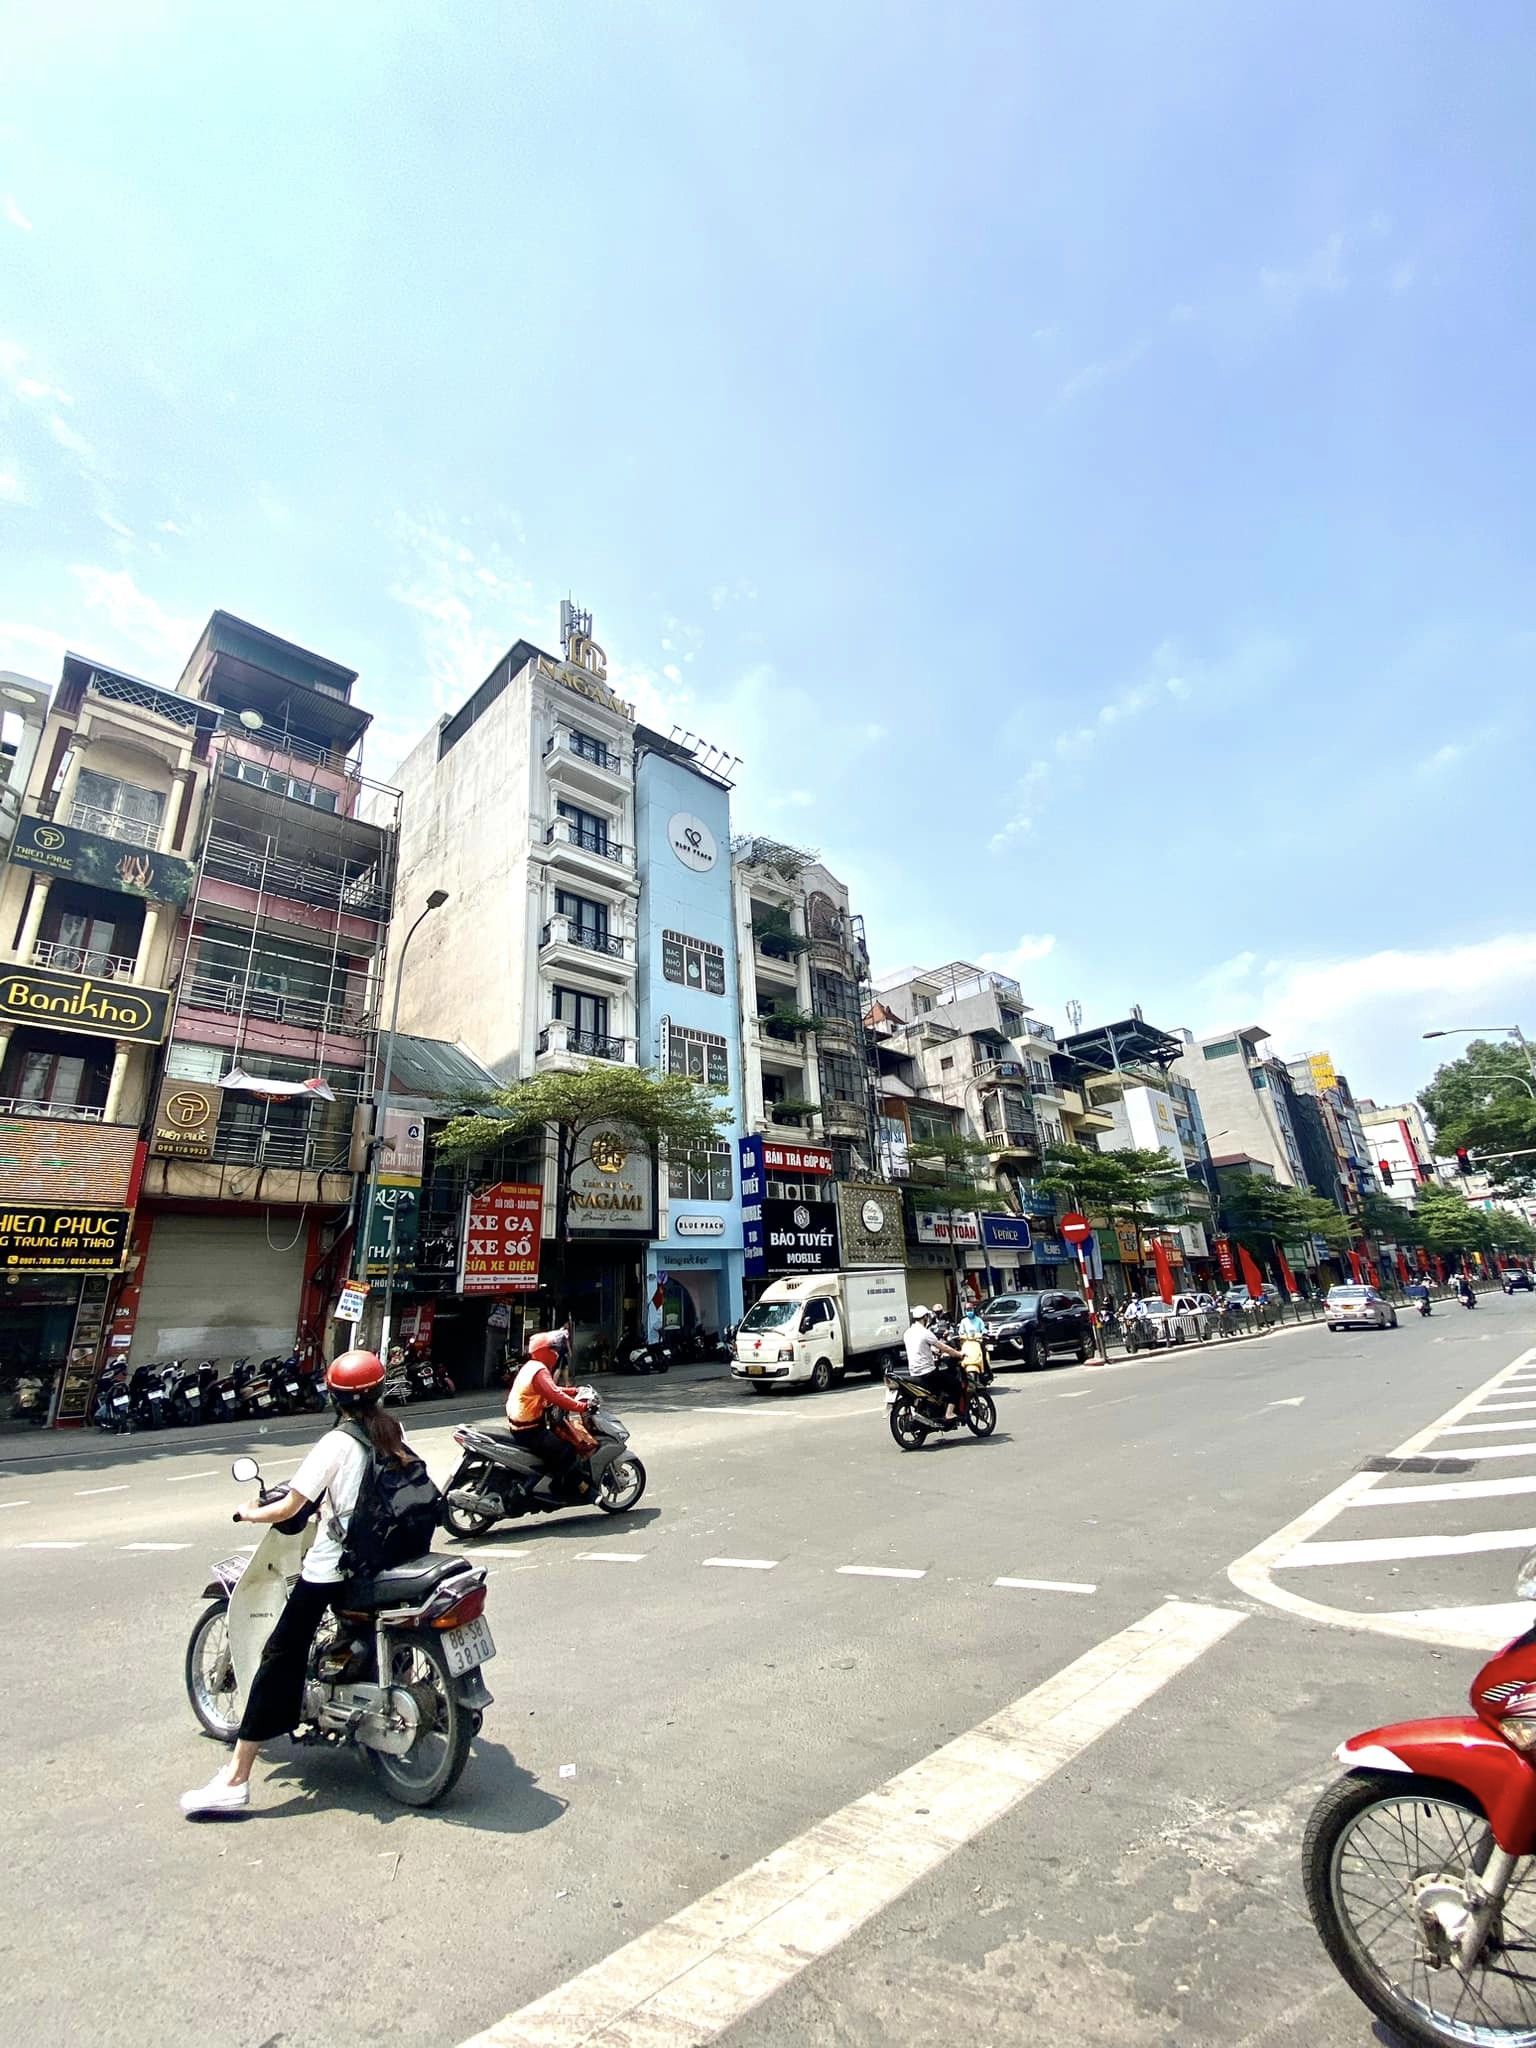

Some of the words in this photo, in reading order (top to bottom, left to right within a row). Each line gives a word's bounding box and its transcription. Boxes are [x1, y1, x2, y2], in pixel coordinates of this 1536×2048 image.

[537, 653, 636, 722] NAGAMI
[675, 841, 690, 852] BLUE
[693, 849, 712, 861] PEACH
[8, 981, 137, 1025] Banikha
[765, 1148, 783, 1165] BÁN
[804, 1151, 818, 1169] GÓP
[819, 1156, 832, 1170] 0%
[470, 1215, 498, 1230] XE
[504, 1216, 534, 1231] GA
[13, 1237, 59, 1247] TRUNG
[770, 1228, 795, 1246] BẢO
[797, 1227, 834, 1247] TUYẾT
[992, 1226, 1019, 1241] Venice
[469, 1240, 498, 1255] XE
[504, 1234, 531, 1256] SỐ
[491, 1261, 504, 1271] XE
[787, 1253, 822, 1264] MOBILE
[455, 1639, 489, 1669] 3810
